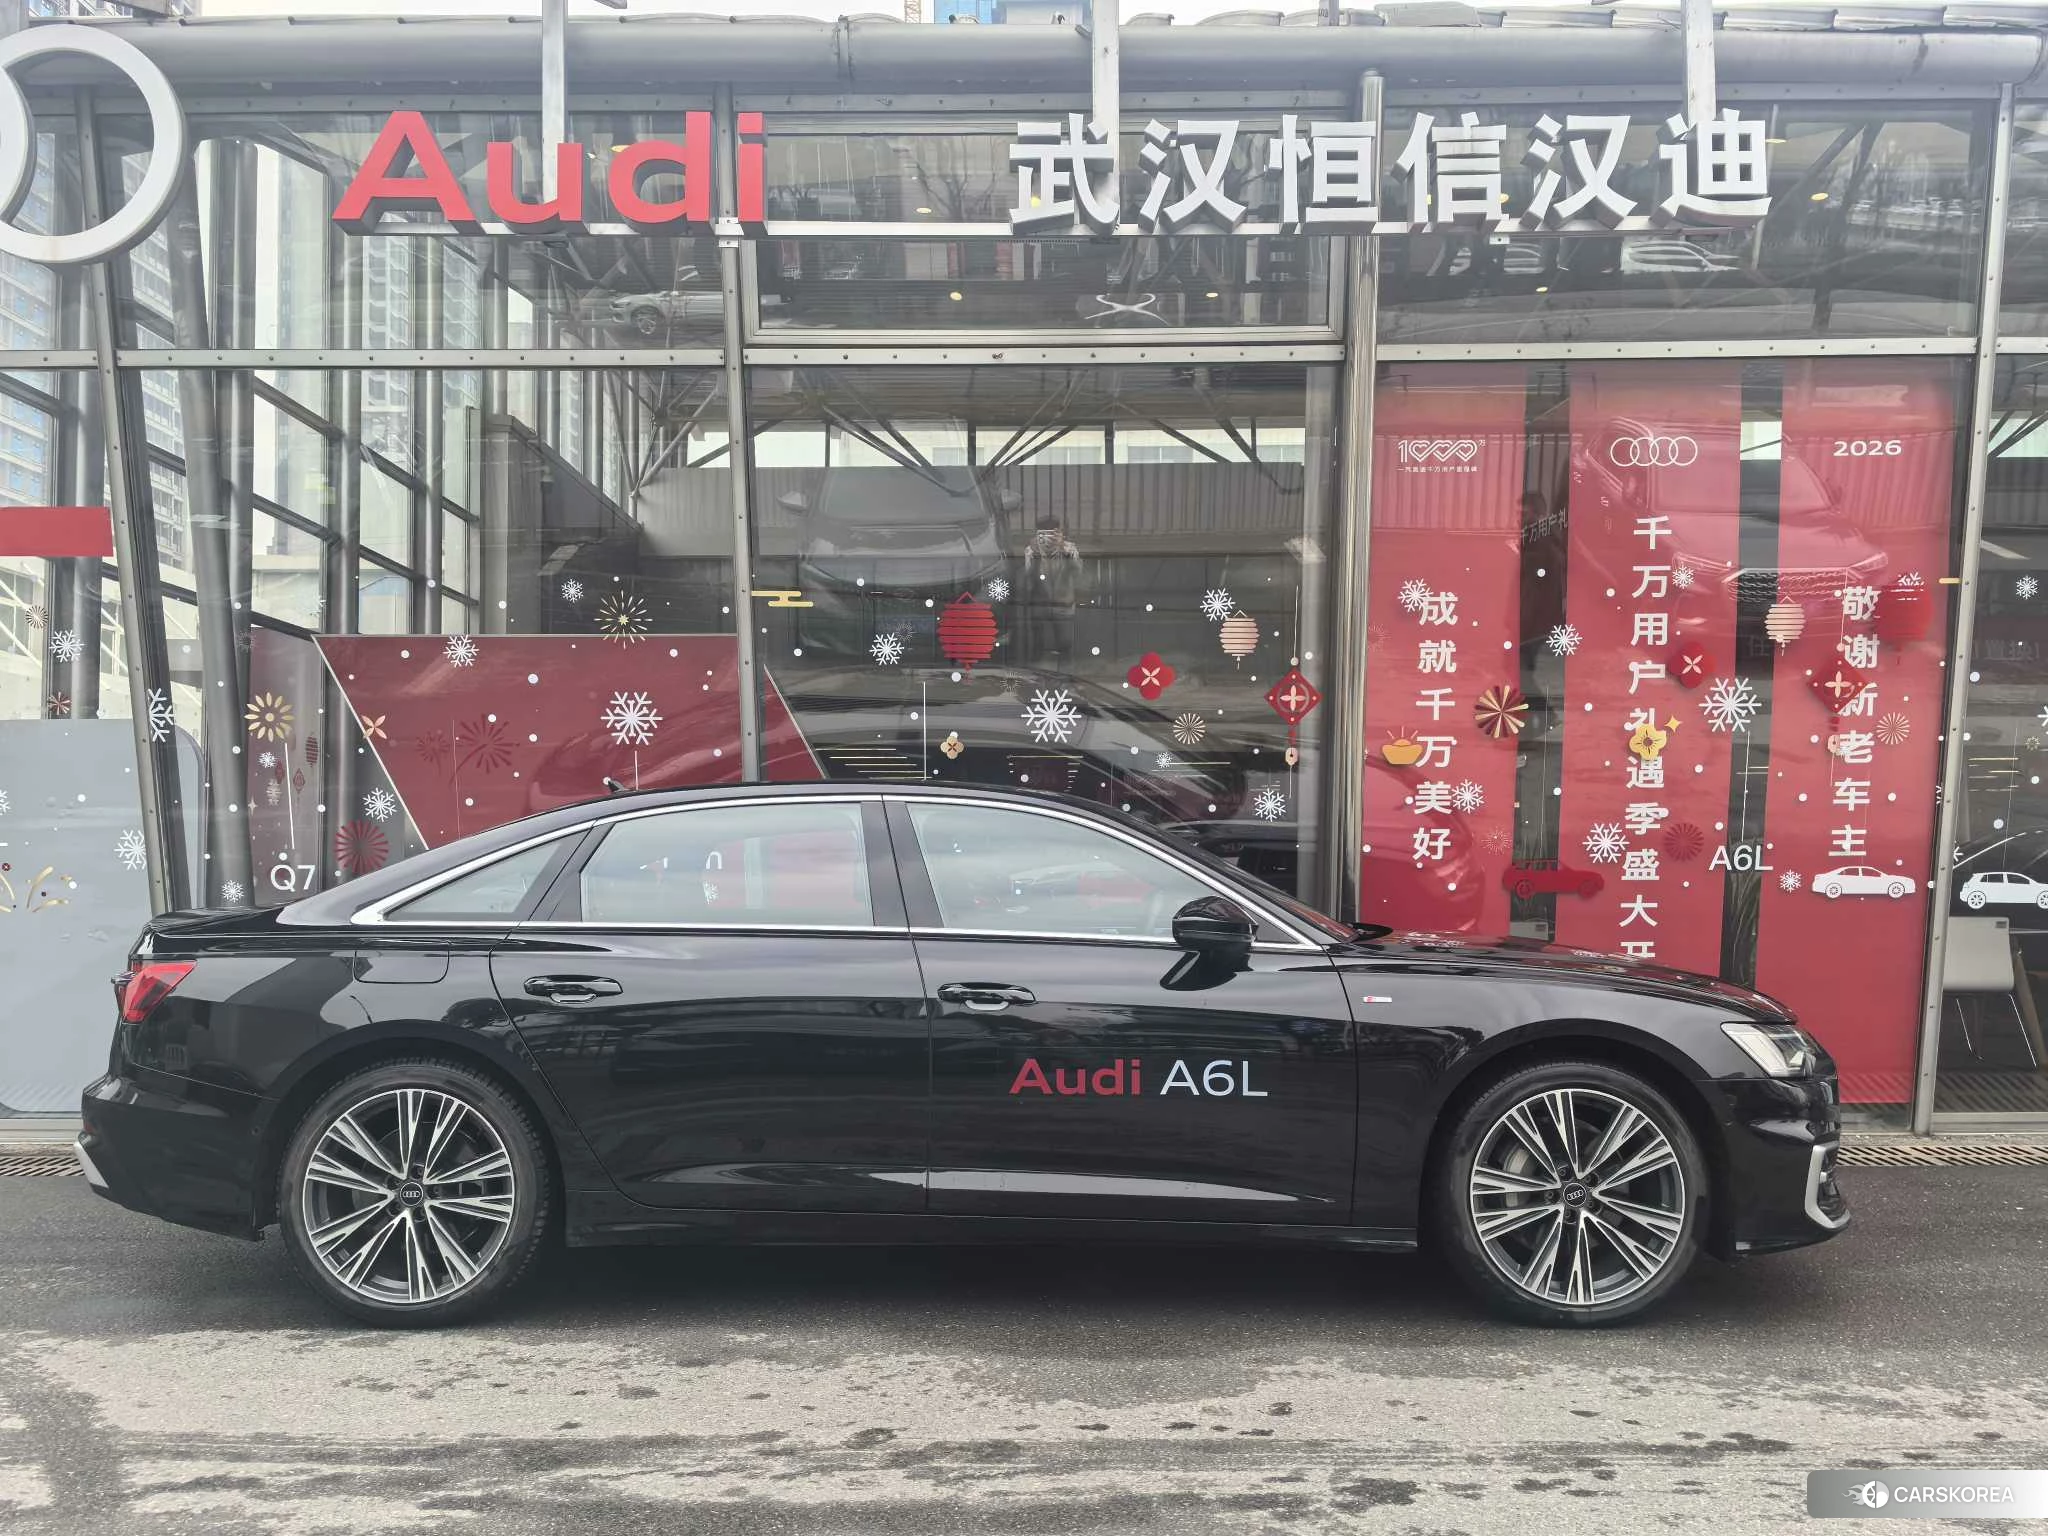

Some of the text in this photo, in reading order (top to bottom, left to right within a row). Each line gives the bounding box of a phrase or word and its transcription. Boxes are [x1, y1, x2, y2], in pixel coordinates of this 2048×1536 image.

[332, 108, 1773, 233] Audi 武汉恒信汉迪
[1833, 439, 1902, 457] 2026
[1412, 591, 1458, 860] 成就千万美好
[1828, 585, 1881, 857] 敬谢新老车主
[271, 864, 315, 892] Q7
[1709, 845, 1774, 872] A6L
[1010, 1058, 1268, 1097] Audi A6L
